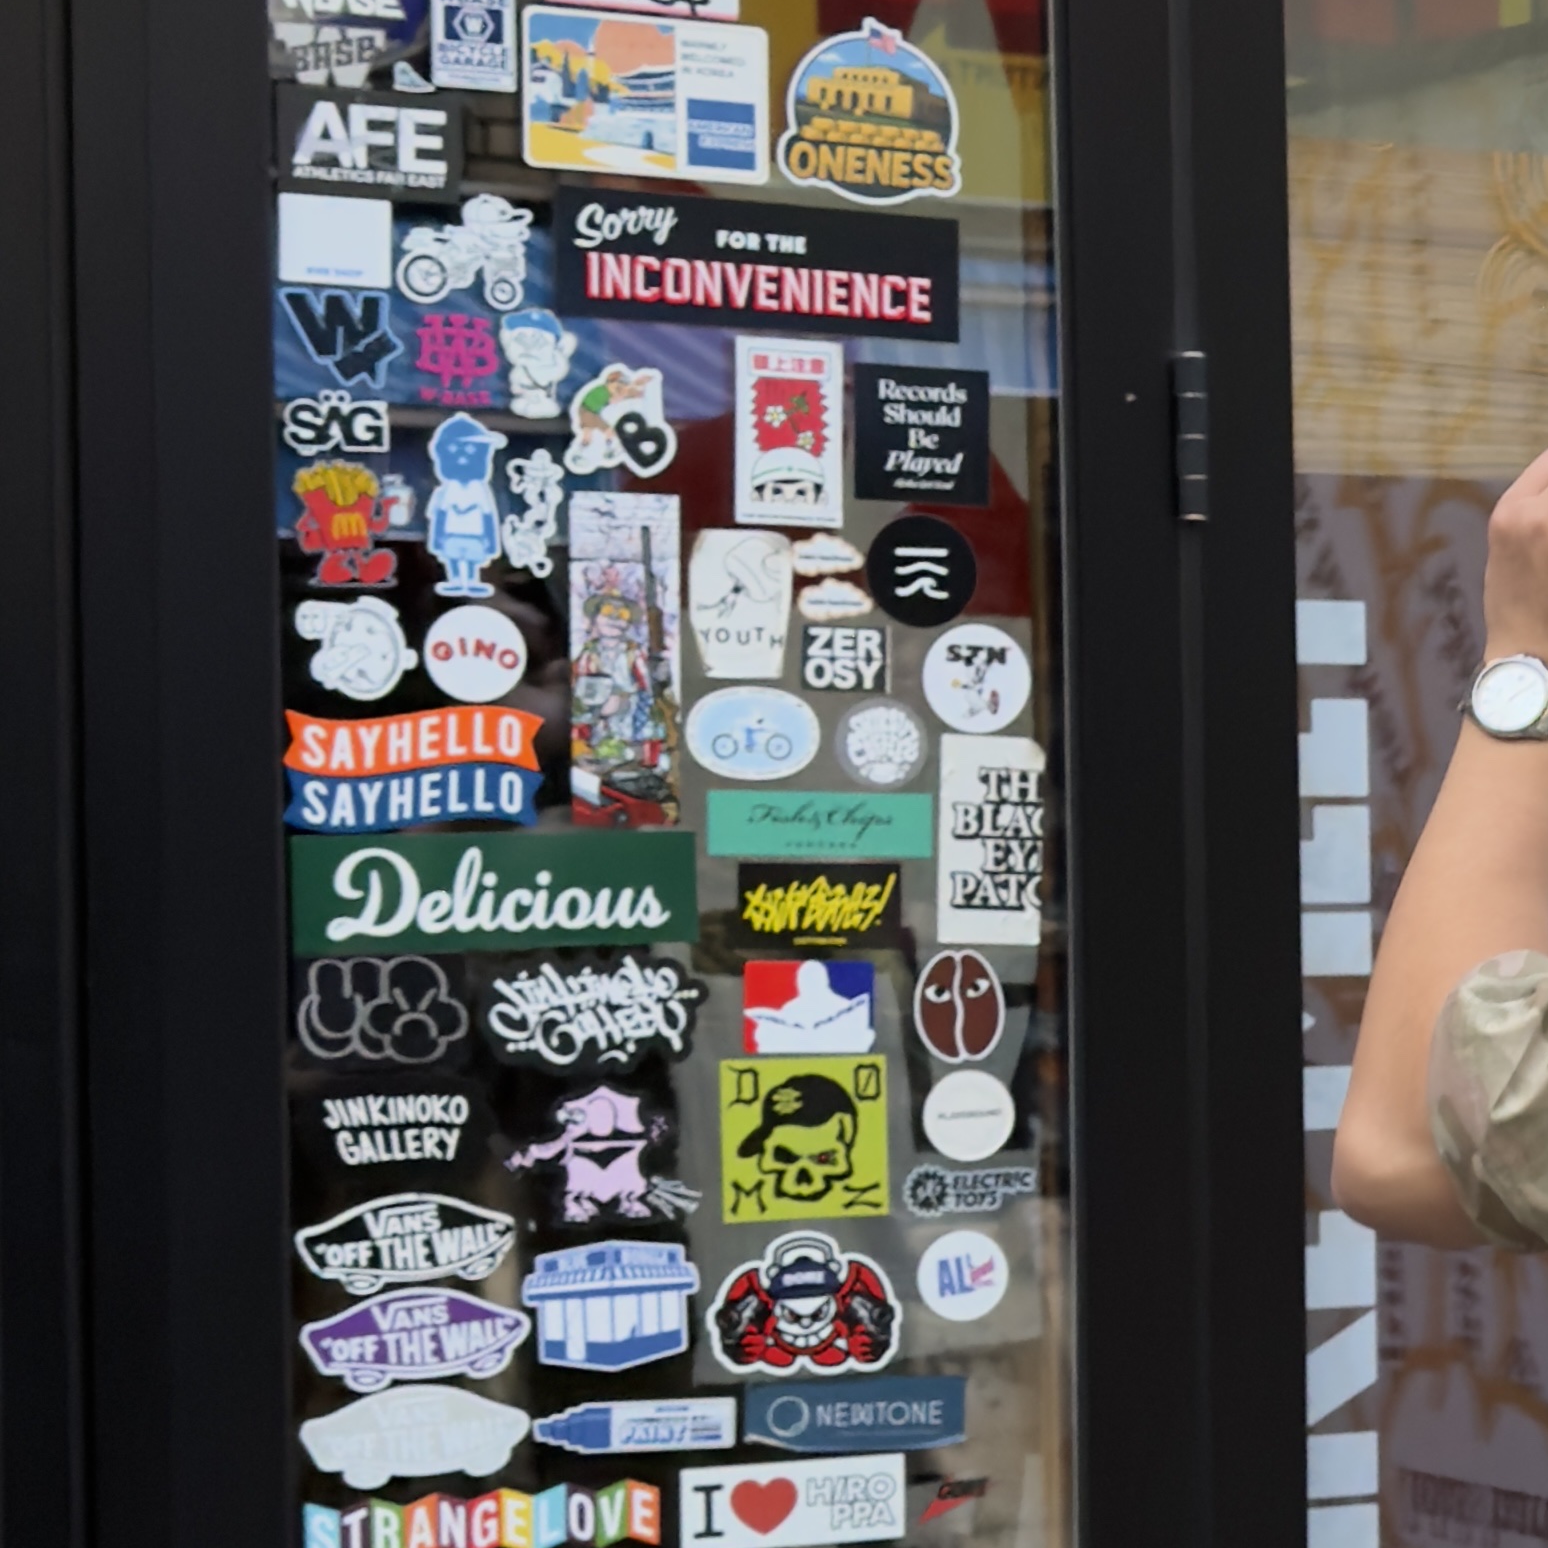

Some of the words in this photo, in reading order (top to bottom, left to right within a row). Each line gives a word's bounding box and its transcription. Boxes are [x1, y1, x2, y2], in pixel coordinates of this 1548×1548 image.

[292, 100, 448, 175] AFE
[292, 164, 375, 185] ATHLETICS
[407, 171, 448, 189] EAST
[788, 142, 954, 190] ONENESS
[574, 202, 678, 249] Sorry
[716, 229, 761, 251] FOR
[765, 232, 807, 255] THE
[585, 250, 933, 325] INCONVENIENCE
[878, 378, 969, 403] Records
[883, 403, 962, 427] Should
[908, 428, 939, 450] Be
[884, 450, 964, 477] Played
[699, 626, 784, 650] YOUTH
[807, 626, 884, 658] ZER
[804, 659, 883, 690] OSY
[301, 711, 523, 771] SAYHELLO
[301, 768, 524, 827] SAYHELLO
[977, 765, 1043, 804] TH
[952, 802, 1044, 839] BLA
[978, 838, 1043, 874] EY
[324, 846, 672, 942] Delicious
[950, 870, 1043, 912] PAT
[322, 1094, 470, 1130] JINKINOKO
[336, 1127, 462, 1166] GALLERY
[952, 1170, 1032, 1192] ELECTRIC
[953, 1190, 998, 1209] TOYS
[363, 1204, 443, 1238] VANS
[378, 1235, 431, 1269] THE
[370, 1297, 451, 1330] VANS
[386, 1331, 441, 1365] THE
[815, 1400, 944, 1427] NEWTONE
[692, 1484, 724, 1539] I
[805, 1472, 897, 1507] HIRO
[830, 1502, 896, 1530] PPA
